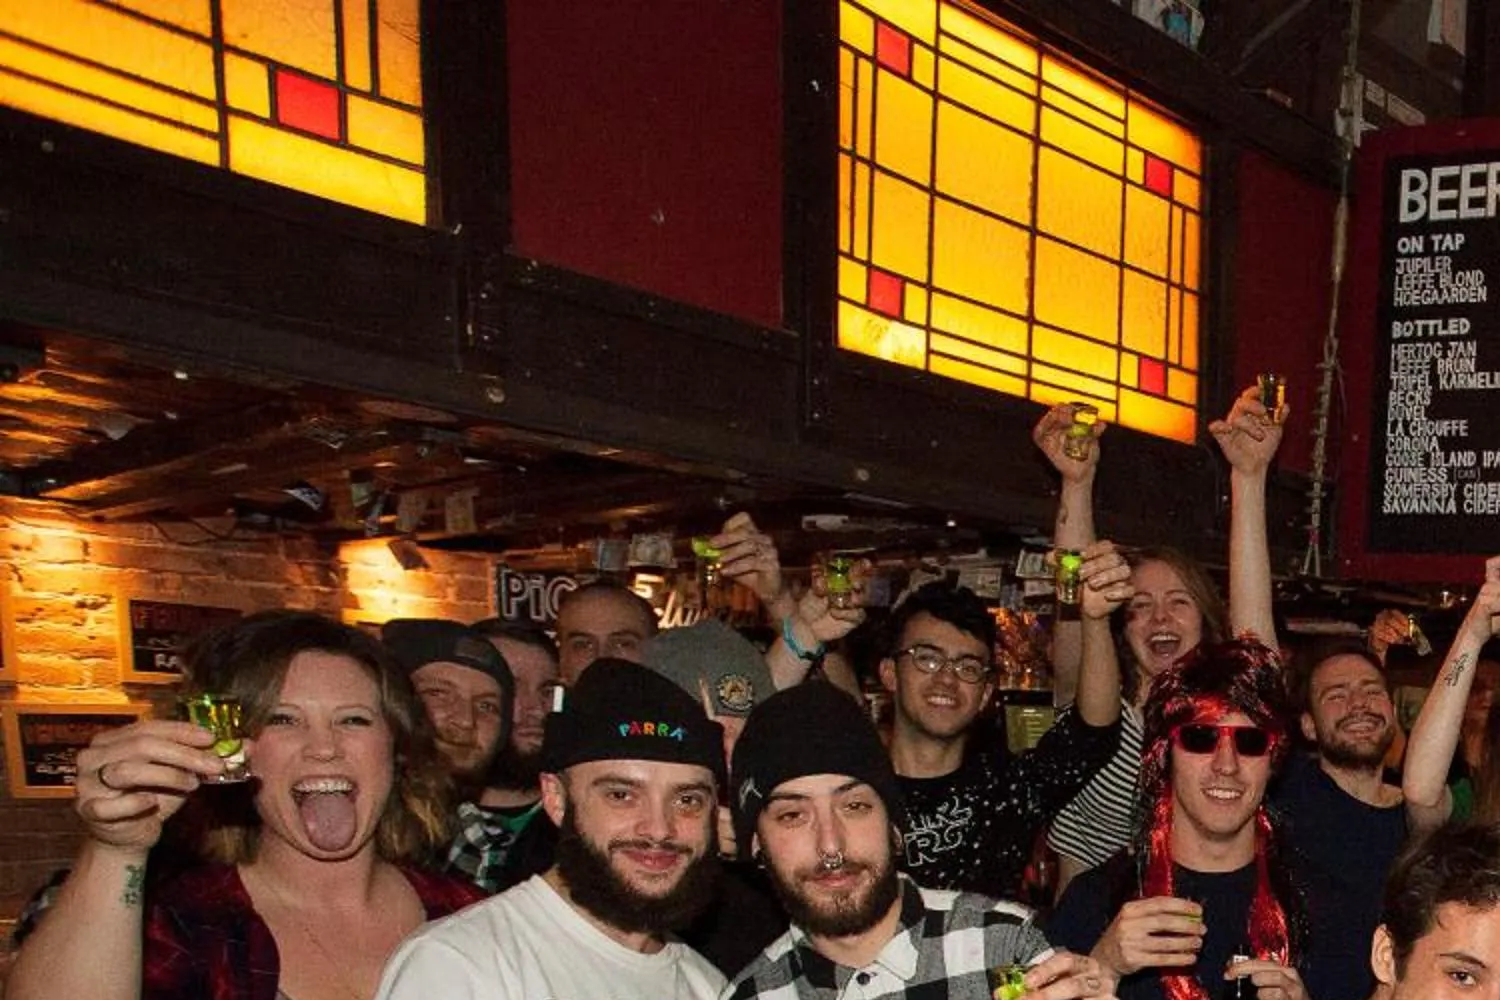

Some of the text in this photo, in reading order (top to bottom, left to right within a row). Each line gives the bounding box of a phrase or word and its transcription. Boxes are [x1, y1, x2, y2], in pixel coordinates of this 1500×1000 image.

[1397, 233, 1465, 254] ON TAP
[1395, 256, 1452, 274] JUPILER
[1394, 273, 1435, 290] LEFFE
[1439, 269, 1485, 288] BLOND
[1393, 286, 1487, 307] HOEGAARDEN
[1391, 318, 1471, 338] BOTTLED
[1391, 340, 1477, 360] HERTOG JAN
[1390, 359, 1431, 375] LEFFE
[1386, 419, 1469, 437] LA CHOUFFE
[1386, 436, 1440, 452] CORONA
[1385, 467, 1448, 483] GUINESS
[1383, 483, 1457, 499] SOMERSBY
[1382, 498, 1457, 514] SAVANNA
